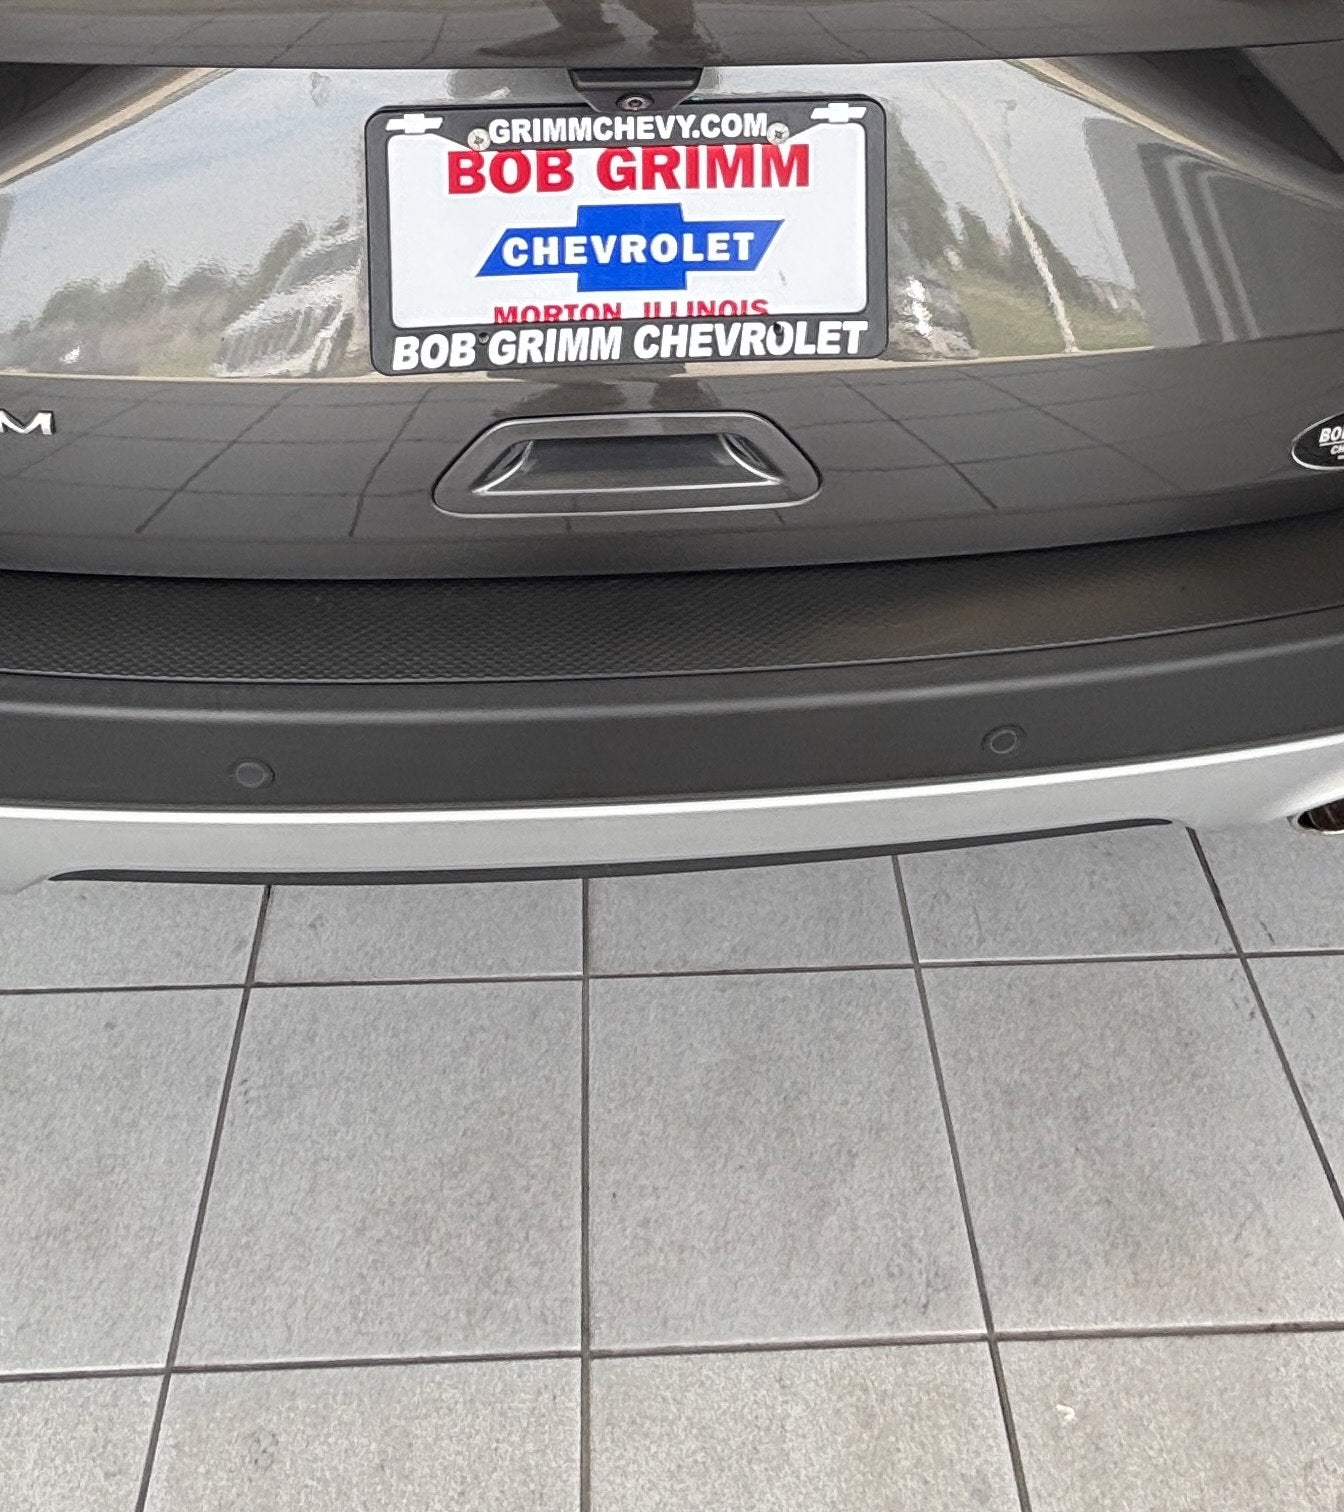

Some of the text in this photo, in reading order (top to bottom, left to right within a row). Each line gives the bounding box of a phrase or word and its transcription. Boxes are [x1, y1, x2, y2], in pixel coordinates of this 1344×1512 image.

[490, 113, 768, 145] GRIMMCHEVY.COM
[448, 143, 810, 195] BOB GRIMM
[502, 233, 755, 267] CHEVROLET
[392, 320, 869, 371] BOB GRIMM CHEVROLET
